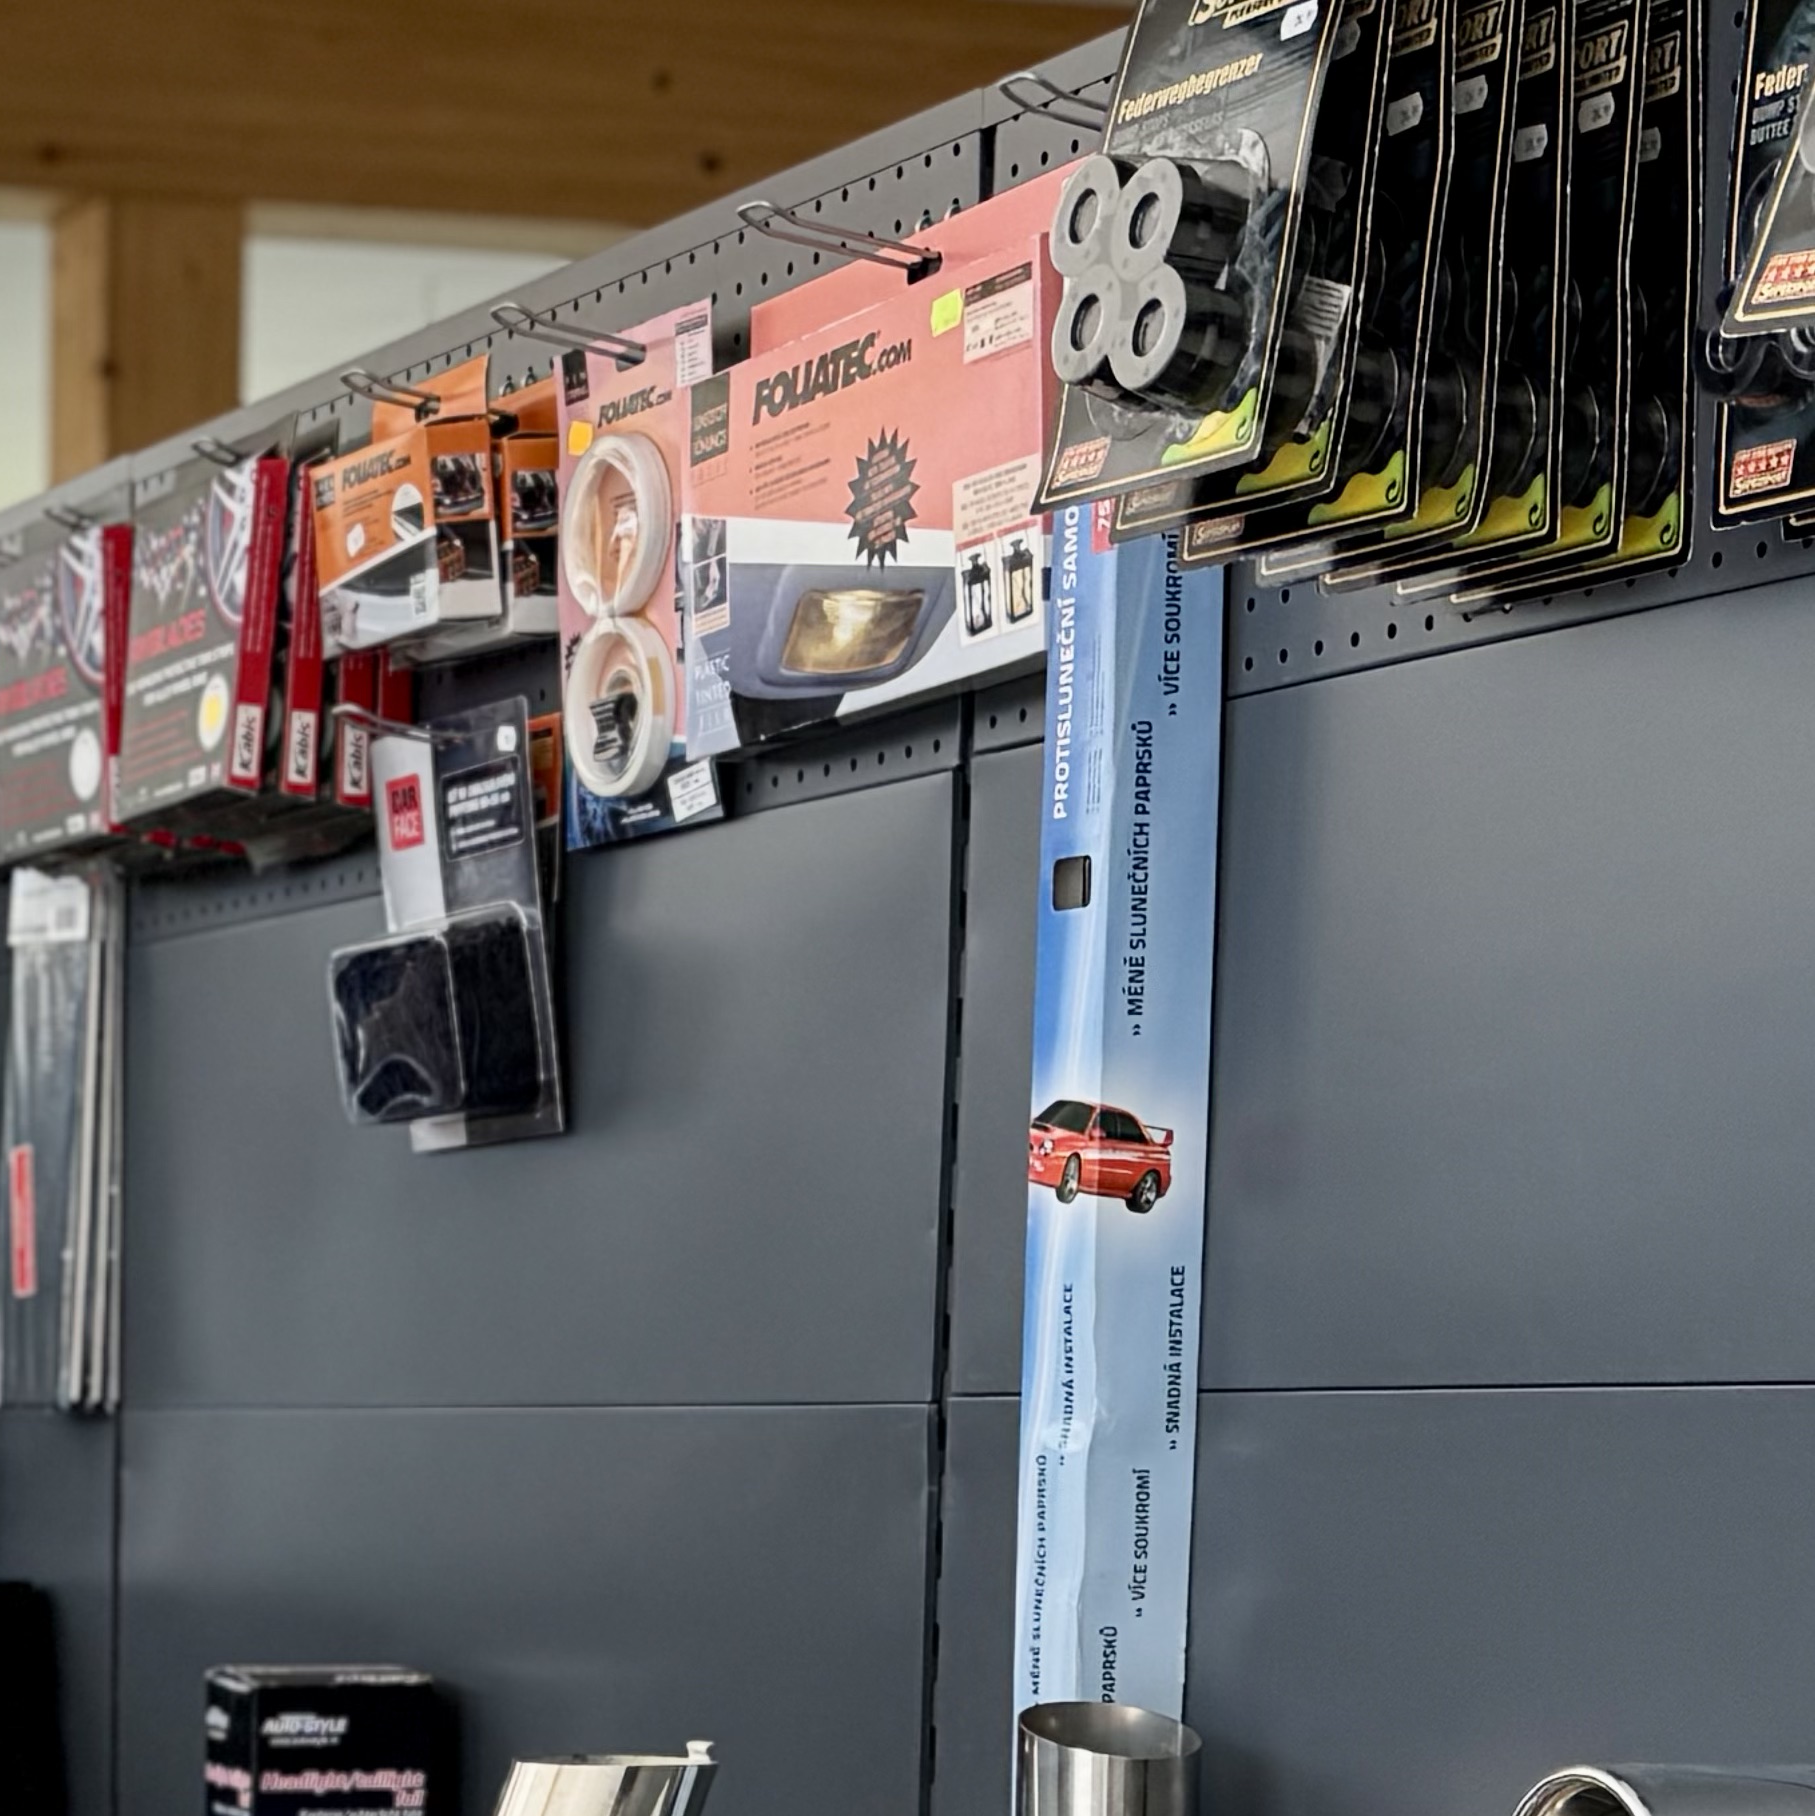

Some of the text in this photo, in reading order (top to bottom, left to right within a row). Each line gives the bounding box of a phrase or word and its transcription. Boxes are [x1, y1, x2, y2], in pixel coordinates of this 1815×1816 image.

[1117, 52, 1265, 125] Federwegbegrenzer
[1754, 63, 1809, 100] Feder
[1052, 505, 1079, 819] PROTISLUNEČNÍ SAMO
[1158, 532, 1183, 696] VÍCE SOUKROMÍ
[1122, 720, 1153, 1016] MÉNĚ SLUNEČNÍCH PAPRSKŮ
[1062, 1283, 1073, 1375] INSTALACE
[1164, 1265, 1185, 1434] SNADNÁ INSTALACE
[1128, 1467, 1151, 1602] VÍCE SOUKROMÍ
[1098, 1625, 1118, 1704] PAPRSKŮ
